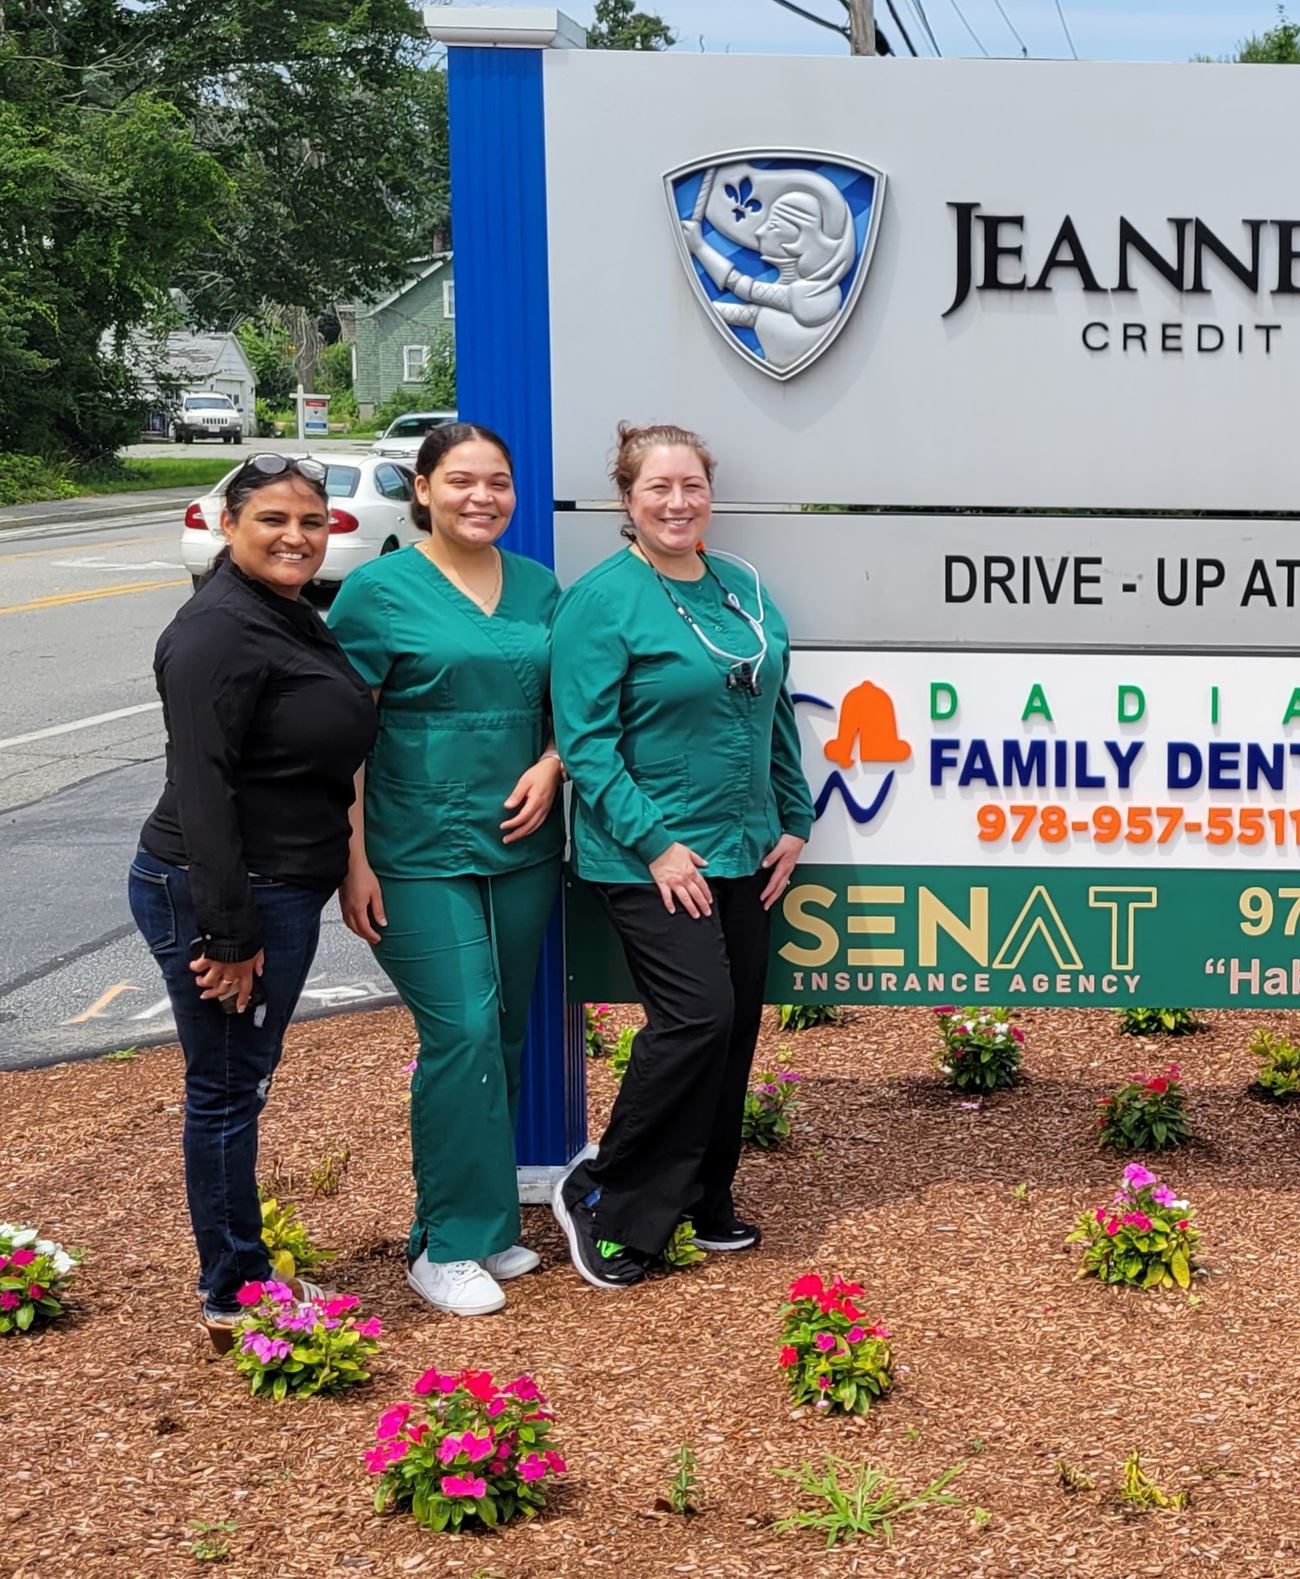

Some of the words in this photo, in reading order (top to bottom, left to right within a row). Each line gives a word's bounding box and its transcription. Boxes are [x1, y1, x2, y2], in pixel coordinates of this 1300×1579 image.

[1081, 321, 1282, 354] CREDIT
[944, 555, 1103, 605] DRIVE
[1156, 557, 1226, 607] UP
[930, 738, 1144, 789] FAMILY
[778, 884, 1158, 971] SENAT
[792, 972, 990, 993] INSURANCE
[1008, 974, 1141, 994] AGENCY
